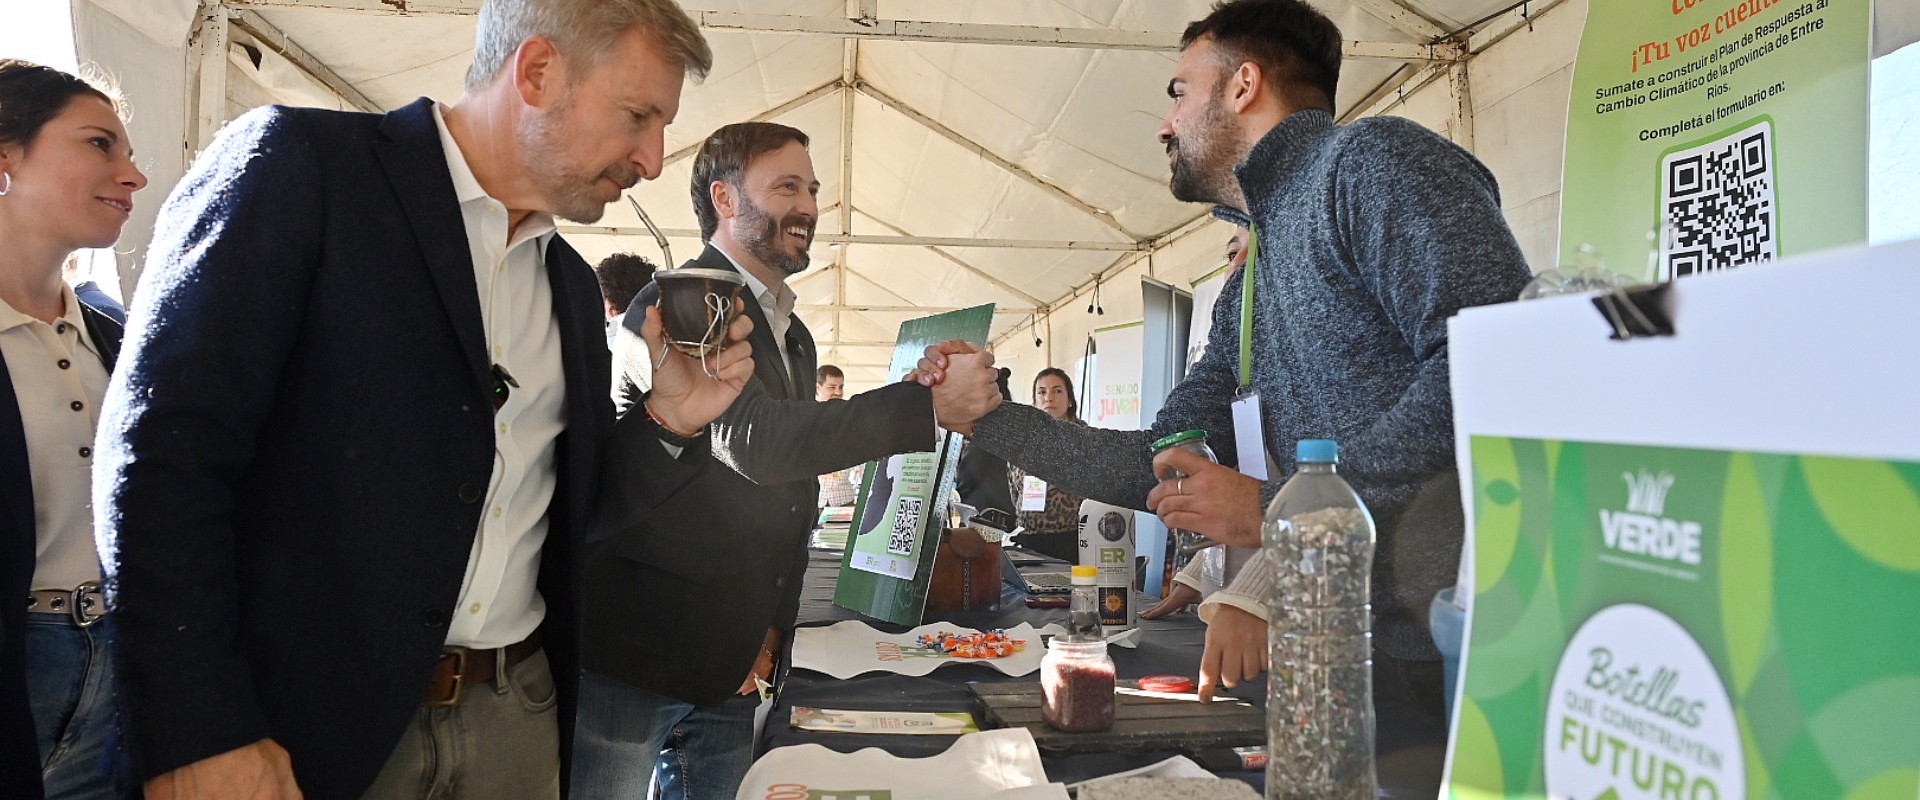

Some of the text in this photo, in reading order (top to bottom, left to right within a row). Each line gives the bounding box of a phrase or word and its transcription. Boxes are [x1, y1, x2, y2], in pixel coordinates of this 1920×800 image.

[1595, 78, 1645, 100] Sumate
[1646, 77, 1656, 87] a
[1658, 55, 1709, 84] construir
[1709, 49, 1719, 63] el
[1718, 40, 1740, 60] Plan
[1741, 33, 1754, 47] de
[1755, 2, 1814, 40] Respuesta
[1595, 17, 1825, 115] Cambio Climático de la provincia de Entre
[1631, 0, 1779, 73] ¡Tu voz cuen
[1638, 80, 1786, 142] Completá el formulario en:
[1105, 383, 1139, 395] SENADO
[1100, 547, 1126, 563] ER
[1599, 509, 1702, 565] VERDE
[1564, 689, 1597, 718] QUE
[1585, 645, 1706, 730] Botellas
[1559, 714, 1720, 800] FUTURO
